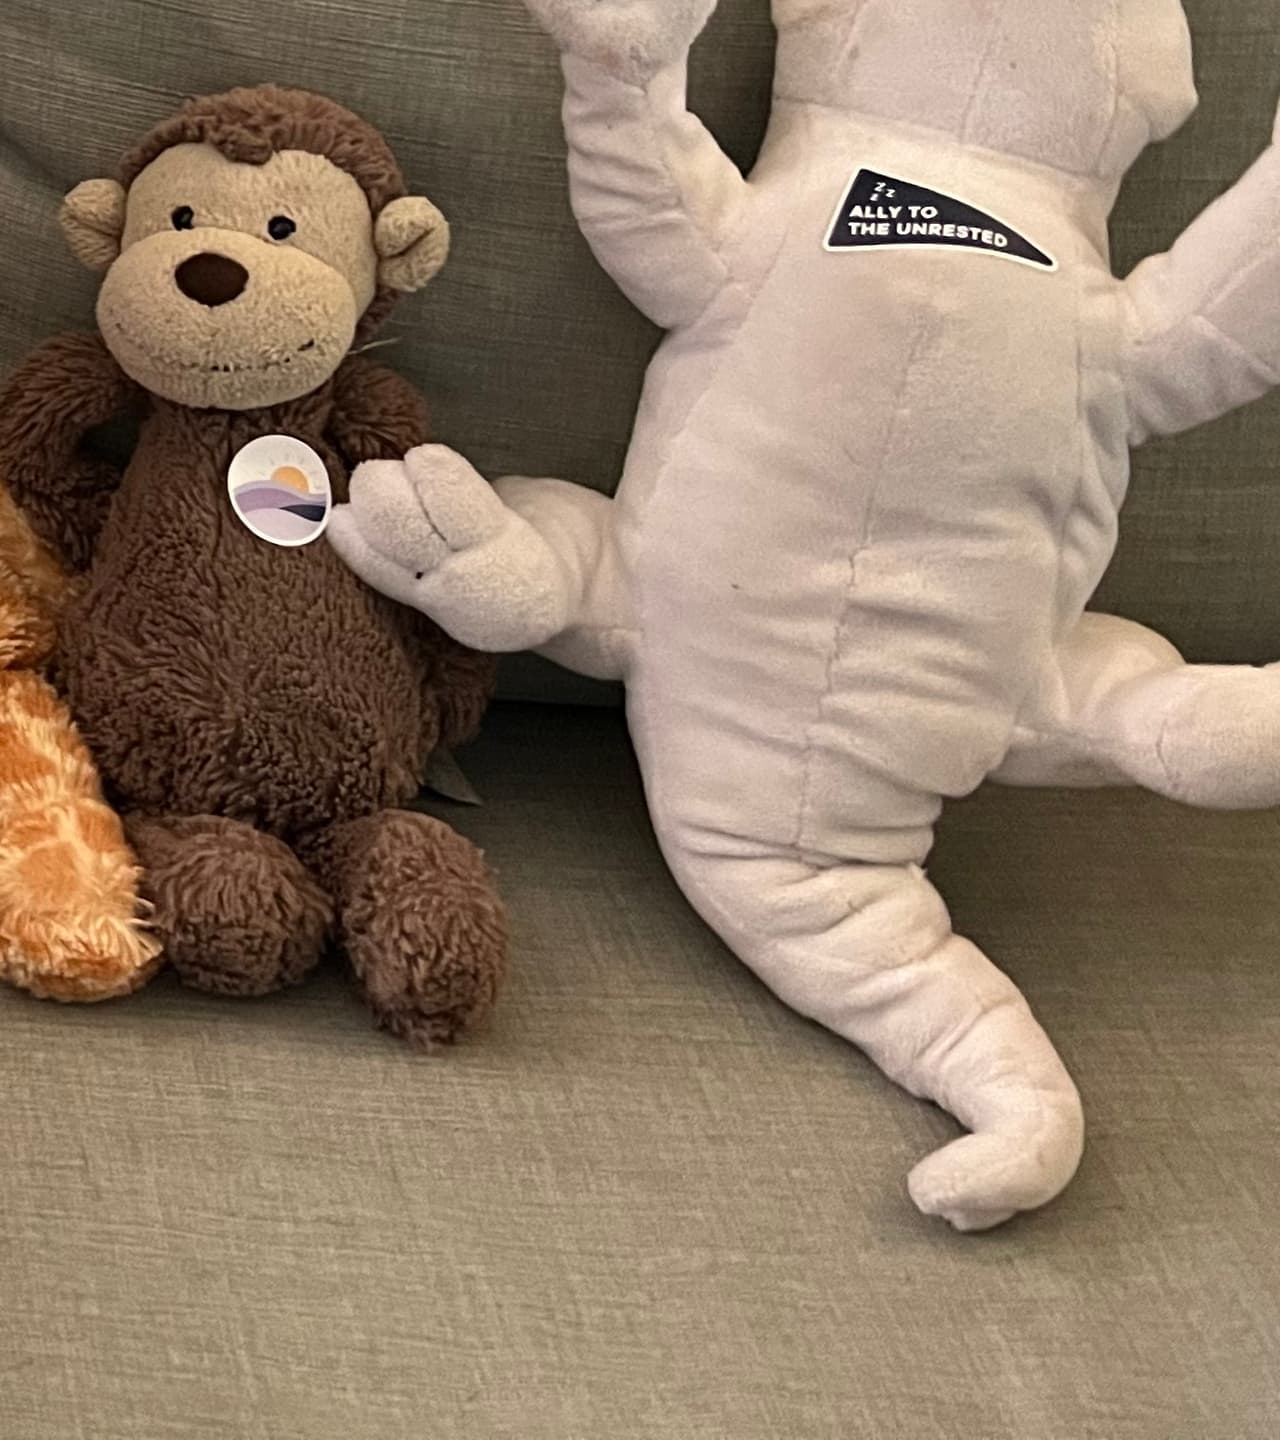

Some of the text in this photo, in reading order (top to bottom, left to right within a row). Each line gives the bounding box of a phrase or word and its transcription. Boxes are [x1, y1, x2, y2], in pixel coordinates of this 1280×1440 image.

[848, 205, 938, 219] ALLY TO
[847, 221, 1008, 248] THE UNRESTED
